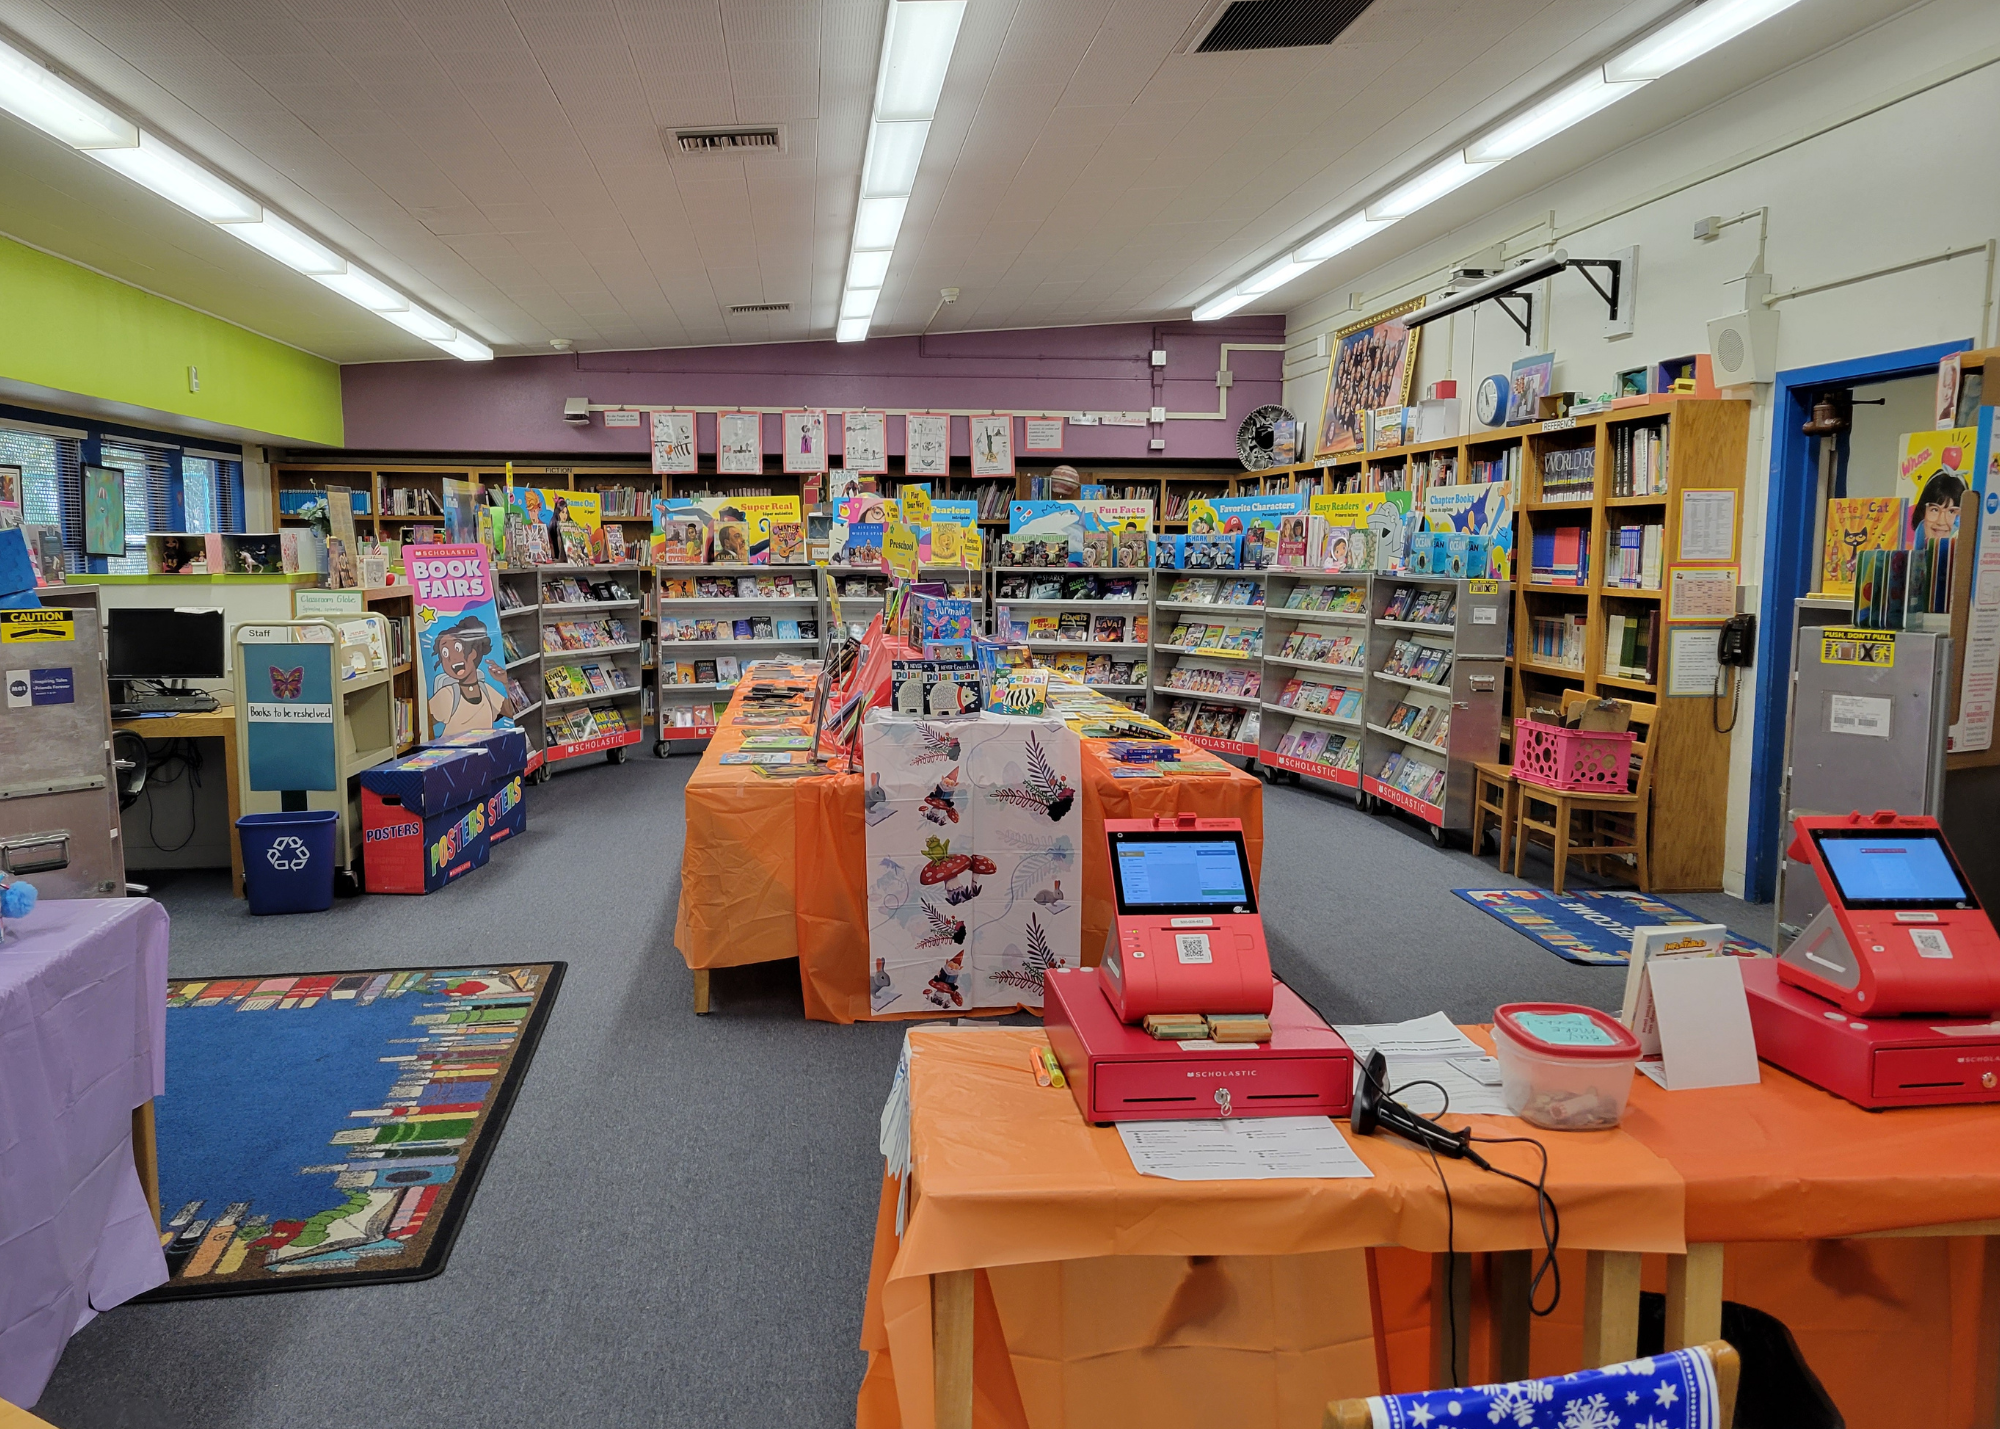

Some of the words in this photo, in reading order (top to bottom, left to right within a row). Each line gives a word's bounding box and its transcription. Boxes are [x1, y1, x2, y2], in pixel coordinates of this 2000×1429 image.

[1543, 419, 1575, 431] REFERENCE
[1544, 451, 1582, 473] WORLD
[1902, 448, 1933, 478] Whoa
[910, 491, 919, 500] Play
[1430, 494, 1454, 505] Chapter
[1455, 493, 1475, 504] Books
[565, 498, 584, 508] Game
[584, 499, 596, 508] On!
[740, 503, 770, 512] Super
[771, 502, 793, 510] Real
[906, 501, 915, 510] Your
[915, 501, 925, 510] Way
[1219, 504, 1251, 513] Favorite
[1251, 502, 1295, 512] Characters
[1314, 502, 1331, 513] Easy
[1331, 501, 1360, 511] Readers
[1836, 502, 1859, 514] Pete
[1869, 501, 1889, 513] Cat
[931, 506, 971, 514] Fearless
[1099, 506, 1118, 514] Fun
[1119, 506, 1146, 514] Facts
[889, 538, 914, 552] Preschool
[1415, 537, 1432, 548] OCEAN
[1450, 540, 1466, 551] OCEAN
[422, 549, 476, 557] SCHOLASTIC
[813, 548, 825, 556] How
[412, 560, 484, 580] BOOK
[418, 579, 486, 599] FAIRS
[300, 595, 334, 603] Classroom
[336, 595, 357, 604] Globe
[10, 612, 64, 622] CAUTION
[1095, 619, 1122, 629] LAVA!
[248, 629, 271, 637] Staff
[1824, 631, 1846, 639] PUSH,
[1847, 632, 1871, 640] DON'T
[896, 670, 921, 680] polar
[927, 673, 951, 683] polar
[953, 671, 978, 681] bear!
[1009, 674, 1046, 685] zebra!
[250, 706, 272, 717] Books
[274, 707, 281, 717] to
[283, 707, 292, 718] be
[293, 707, 331, 718] reshelved
[575, 735, 623, 752] SCHOLASTIC
[1182, 734, 1243, 751] SCHOLASTIC
[1285, 757, 1336, 778] SCHOLASTIC
[1383, 786, 1425, 814] SCHOLASTIC
[366, 822, 420, 843] POSTERS
[430, 802, 485, 877] POSTERS
[1558, 903, 1635, 943] ELCOME
[1664, 939, 1707, 952] INFLATABLES
[1195, 1070, 1257, 1078] SCHOLASTIC
